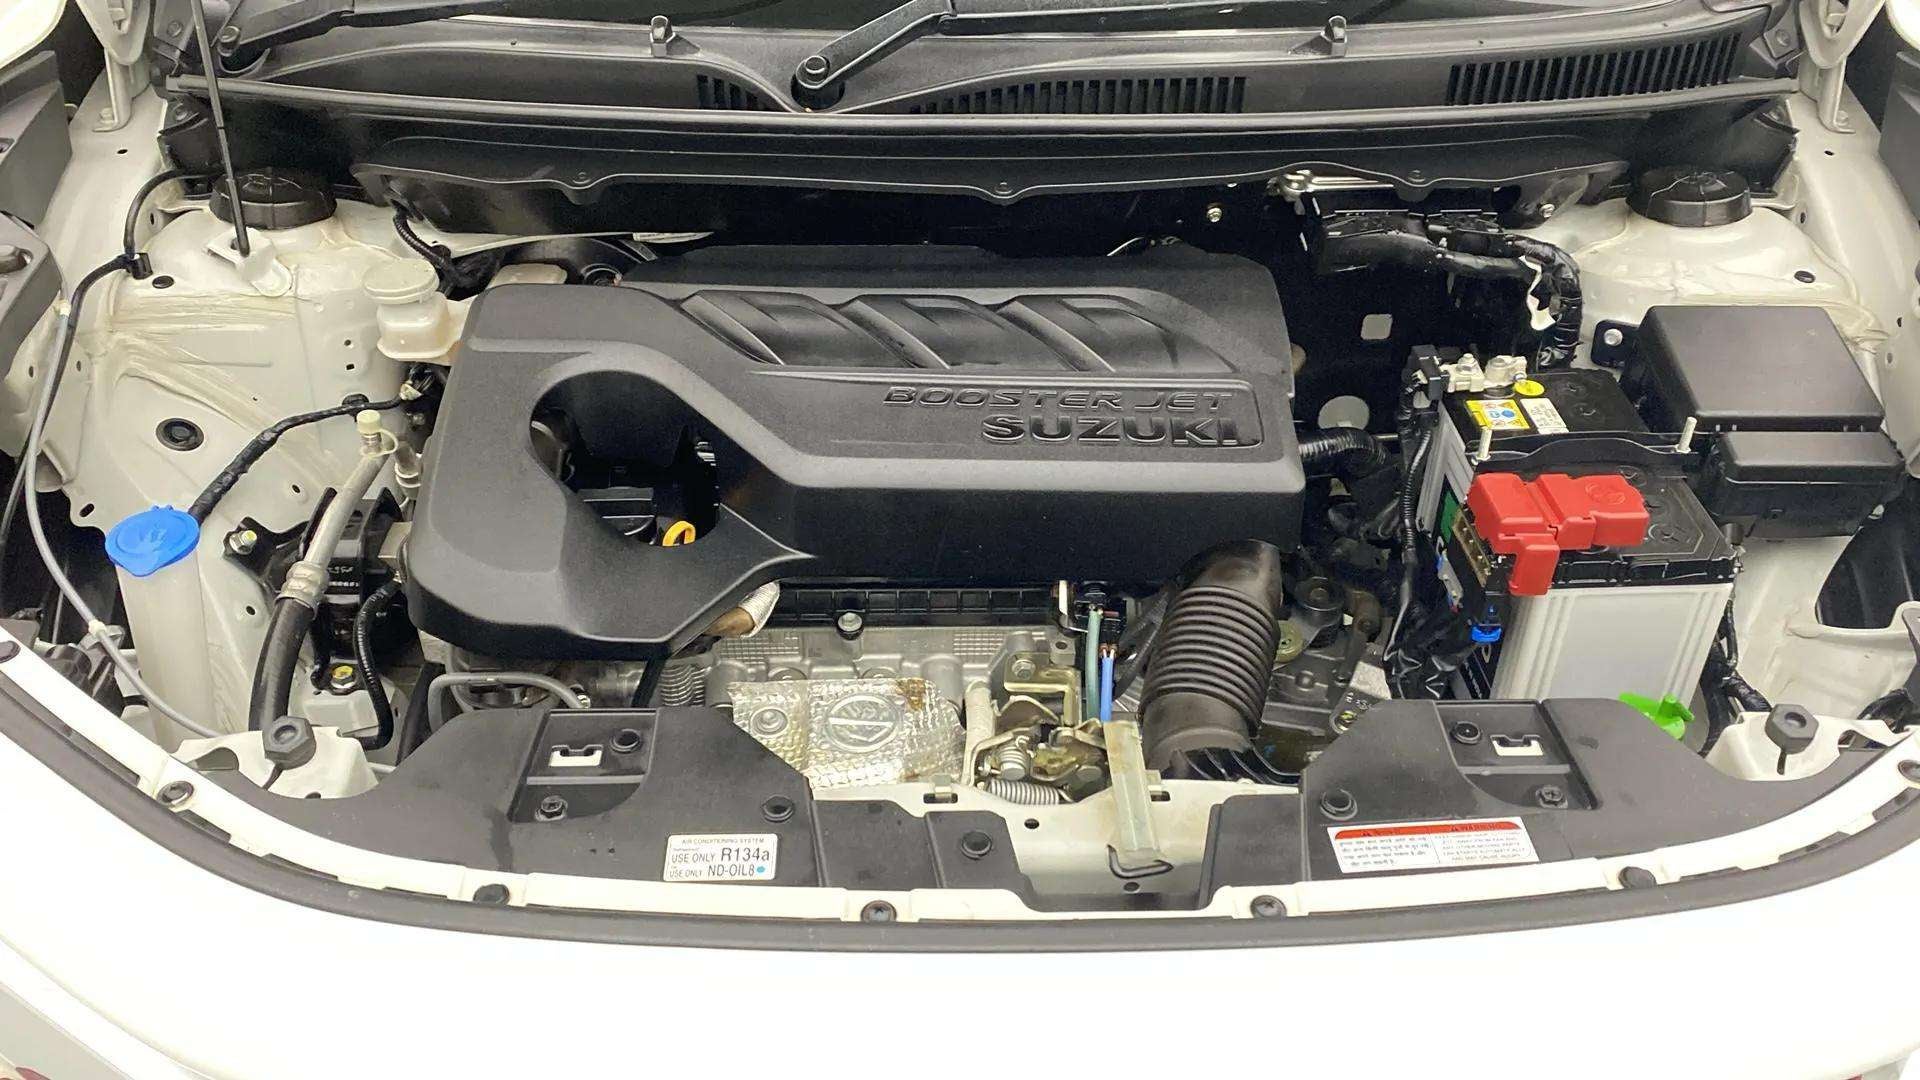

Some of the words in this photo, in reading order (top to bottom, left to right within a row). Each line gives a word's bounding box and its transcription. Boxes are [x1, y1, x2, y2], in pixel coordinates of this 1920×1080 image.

[883, 387, 1123, 411] BOOSTER
[1134, 391, 1233, 412] JET
[981, 414, 1241, 446] SUZUKI
[672, 854, 689, 863] USE
[692, 853, 715, 863] ONLY
[721, 848, 770, 861] R134a
[669, 870, 682, 878] USE
[708, 864, 755, 877] ND-OIL8
